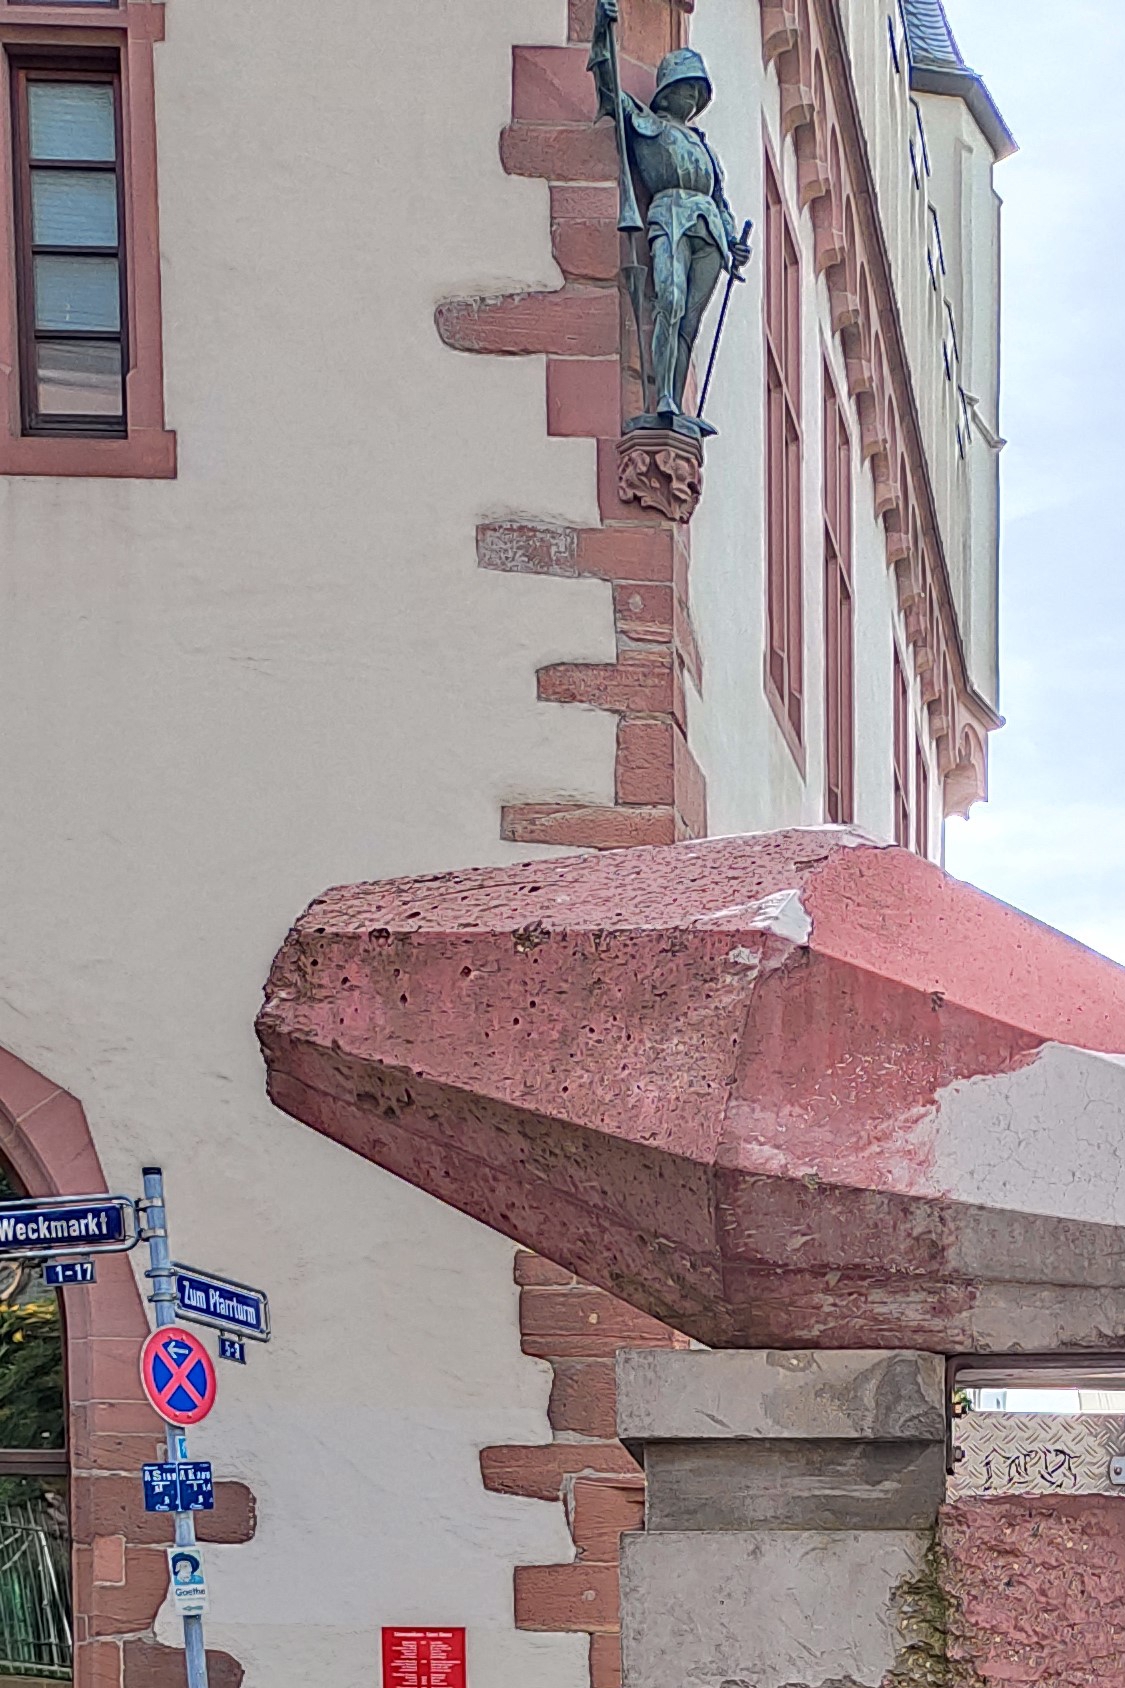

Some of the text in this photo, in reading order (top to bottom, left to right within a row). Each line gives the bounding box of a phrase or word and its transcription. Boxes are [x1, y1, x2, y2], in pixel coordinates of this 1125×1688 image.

[0, 1212, 107, 1241] Weckmarkt
[55, 1263, 92, 1282] 1-17
[182, 1281, 256, 1324] Zum Pfarrturm
